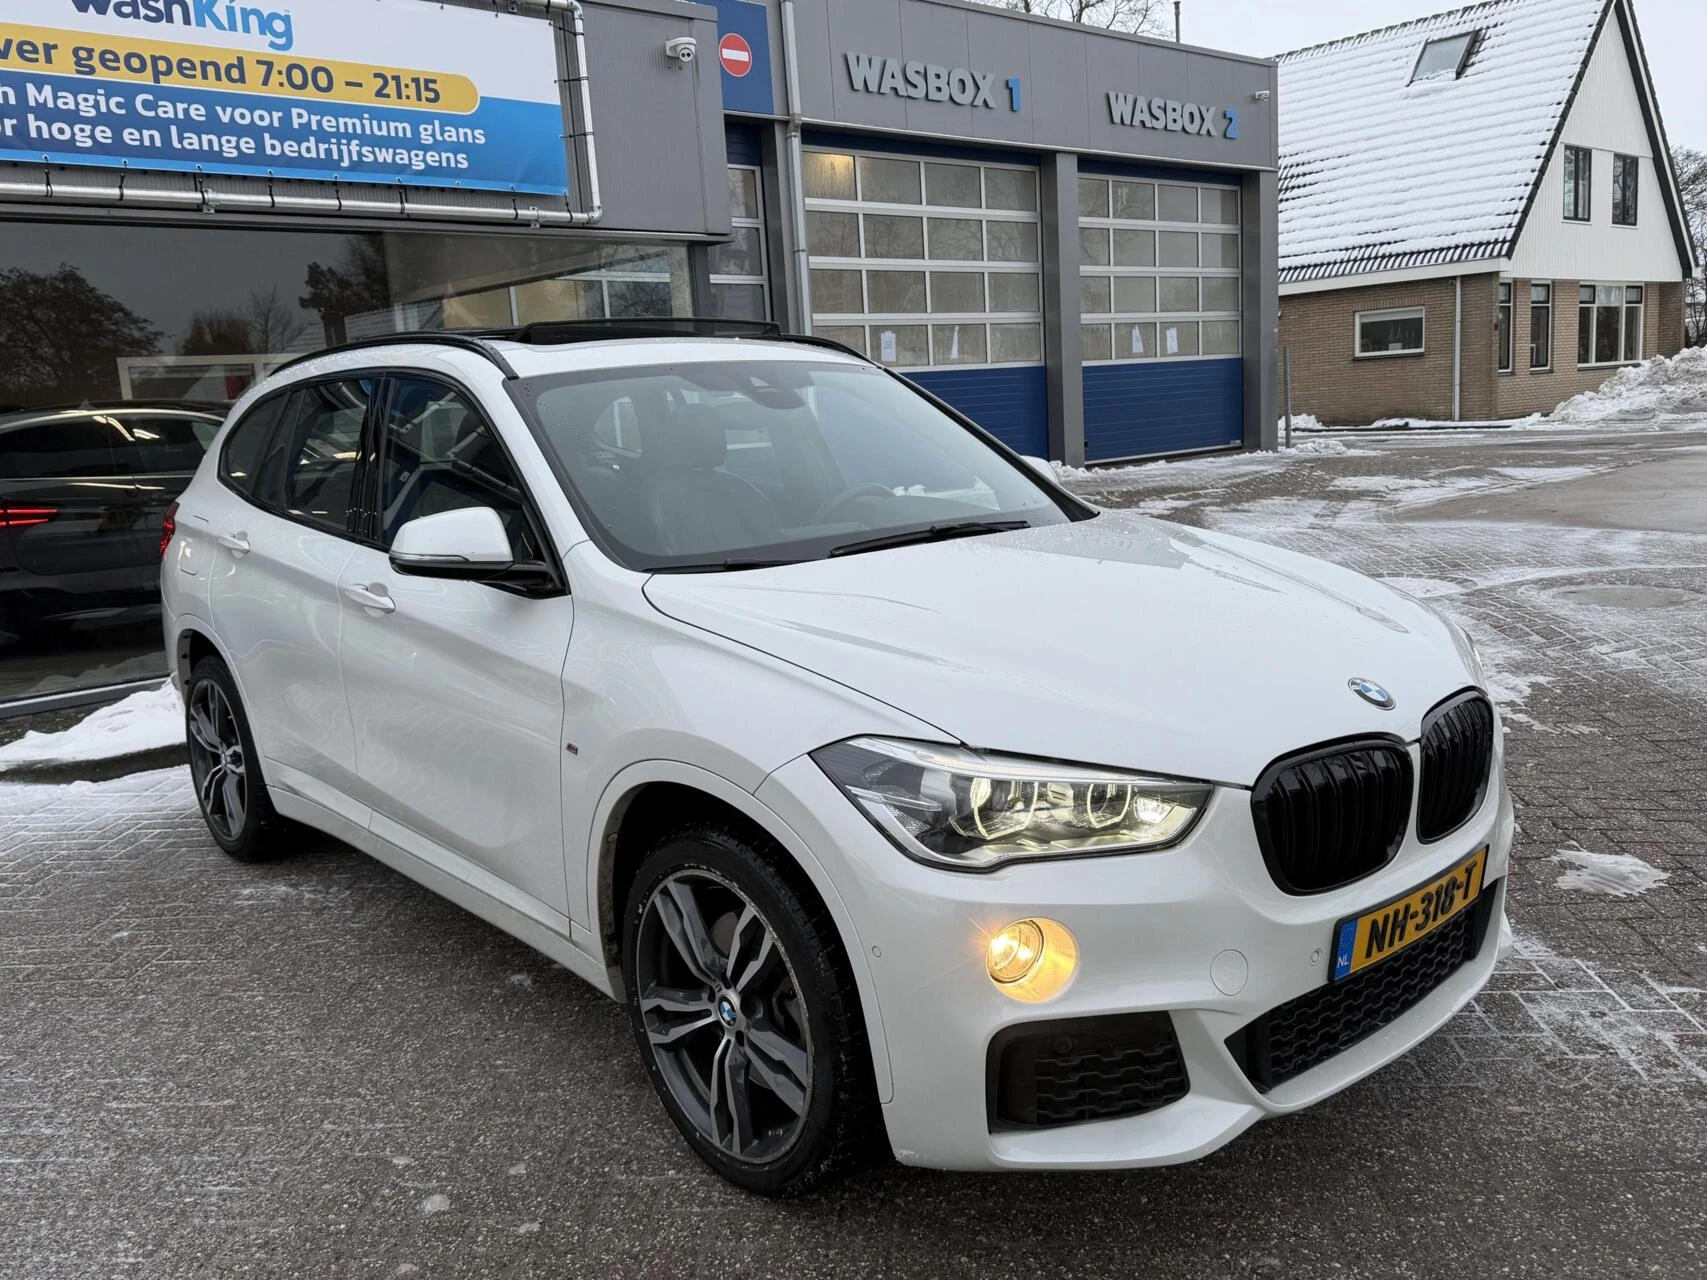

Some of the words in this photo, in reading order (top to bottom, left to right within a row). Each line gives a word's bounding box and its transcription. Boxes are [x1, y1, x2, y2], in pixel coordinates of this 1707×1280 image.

[72, 46, 246, 84] geopend
[255, 59, 334, 93] 7:00
[373, 72, 441, 103] 21:15
[844, 51, 997, 109] WASBOX
[1007, 76, 1022, 112] 1
[25, 82, 126, 117] Magic
[135, 93, 206, 121] Care
[216, 106, 283, 128] voor
[291, 107, 412, 138] Premium
[419, 119, 486, 144] glans
[27, 113, 112, 147] hoge
[122, 127, 162, 148] en
[170, 125, 256, 158] lange
[264, 132, 469, 169] bedrijfswagens
[1107, 90, 1217, 136] WASBOX
[1224, 107, 1239, 140] 2
[1365, 860, 1477, 959] NH-318-T
[1337, 955, 1350, 968] NL
